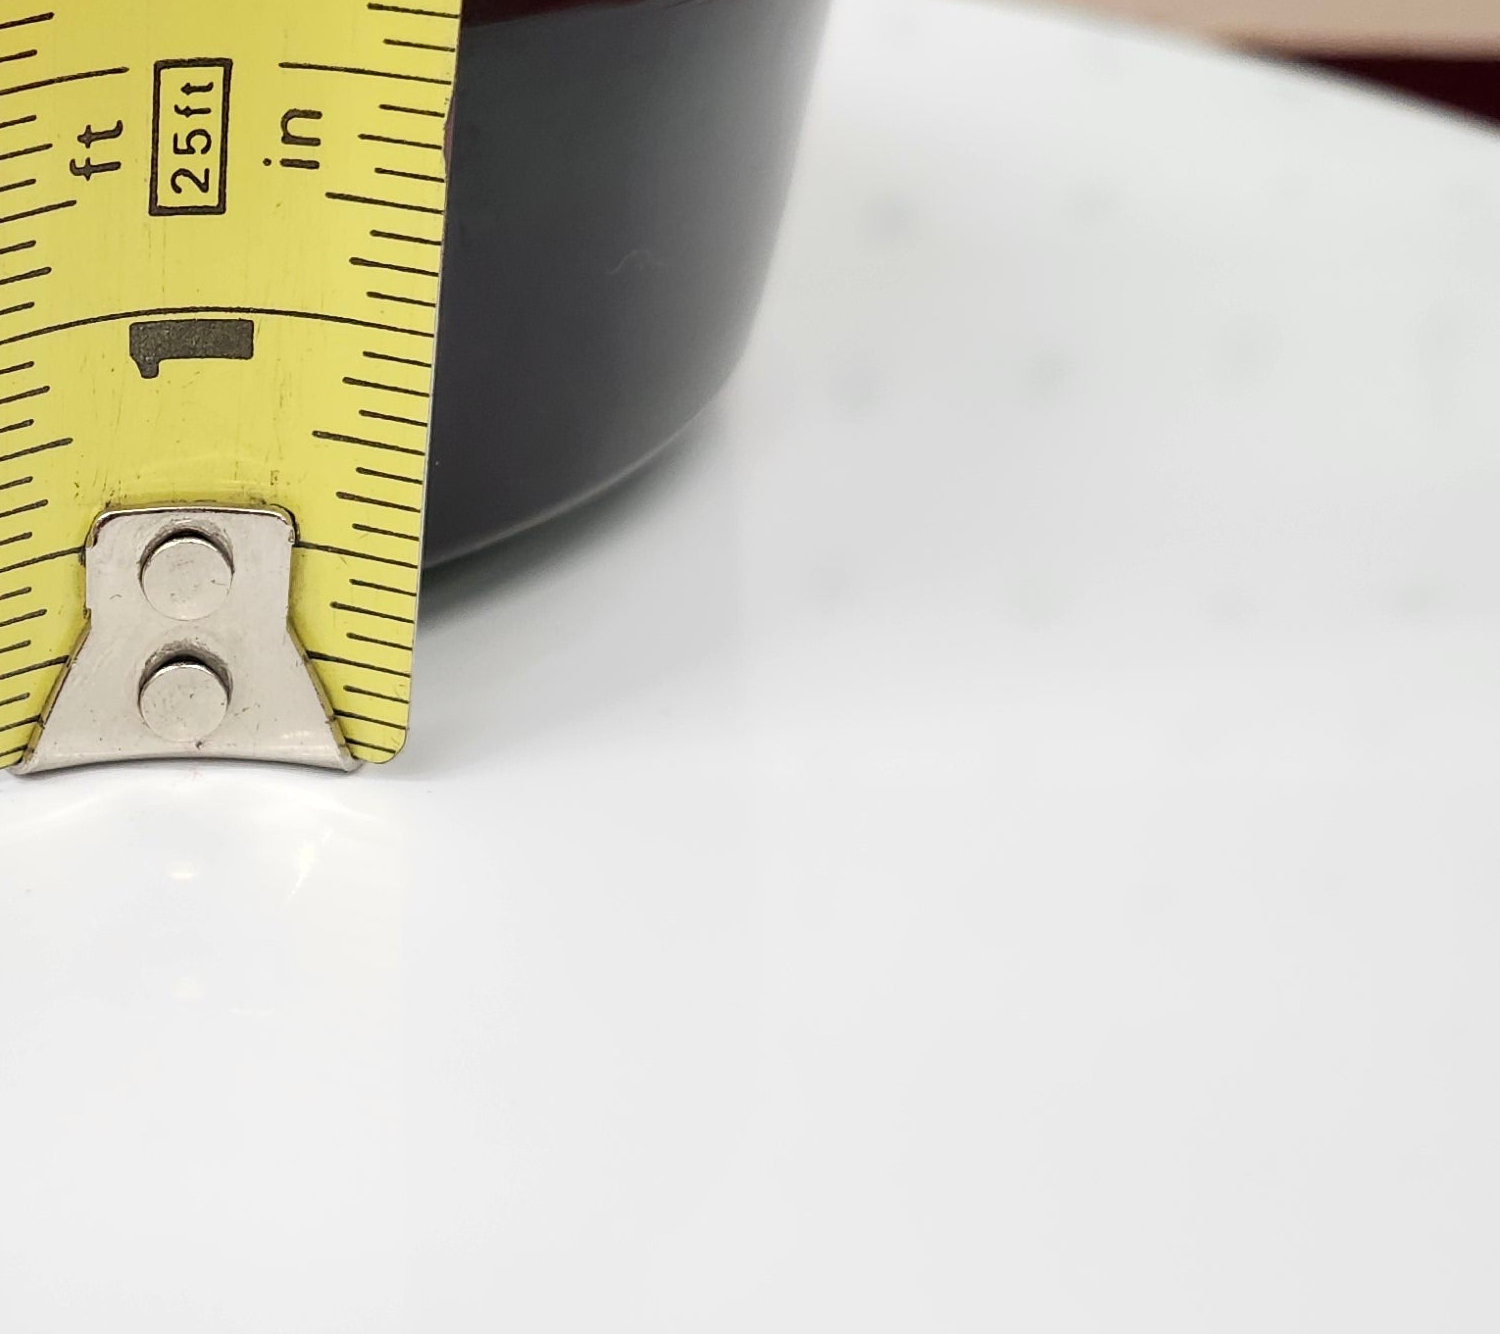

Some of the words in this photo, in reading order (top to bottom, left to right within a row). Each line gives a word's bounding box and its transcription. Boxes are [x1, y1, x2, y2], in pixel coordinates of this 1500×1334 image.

[69, 119, 124, 182] ft
[170, 81, 215, 194] 25ft
[263, 108, 323, 170] in
[129, 318, 254, 379] 1
